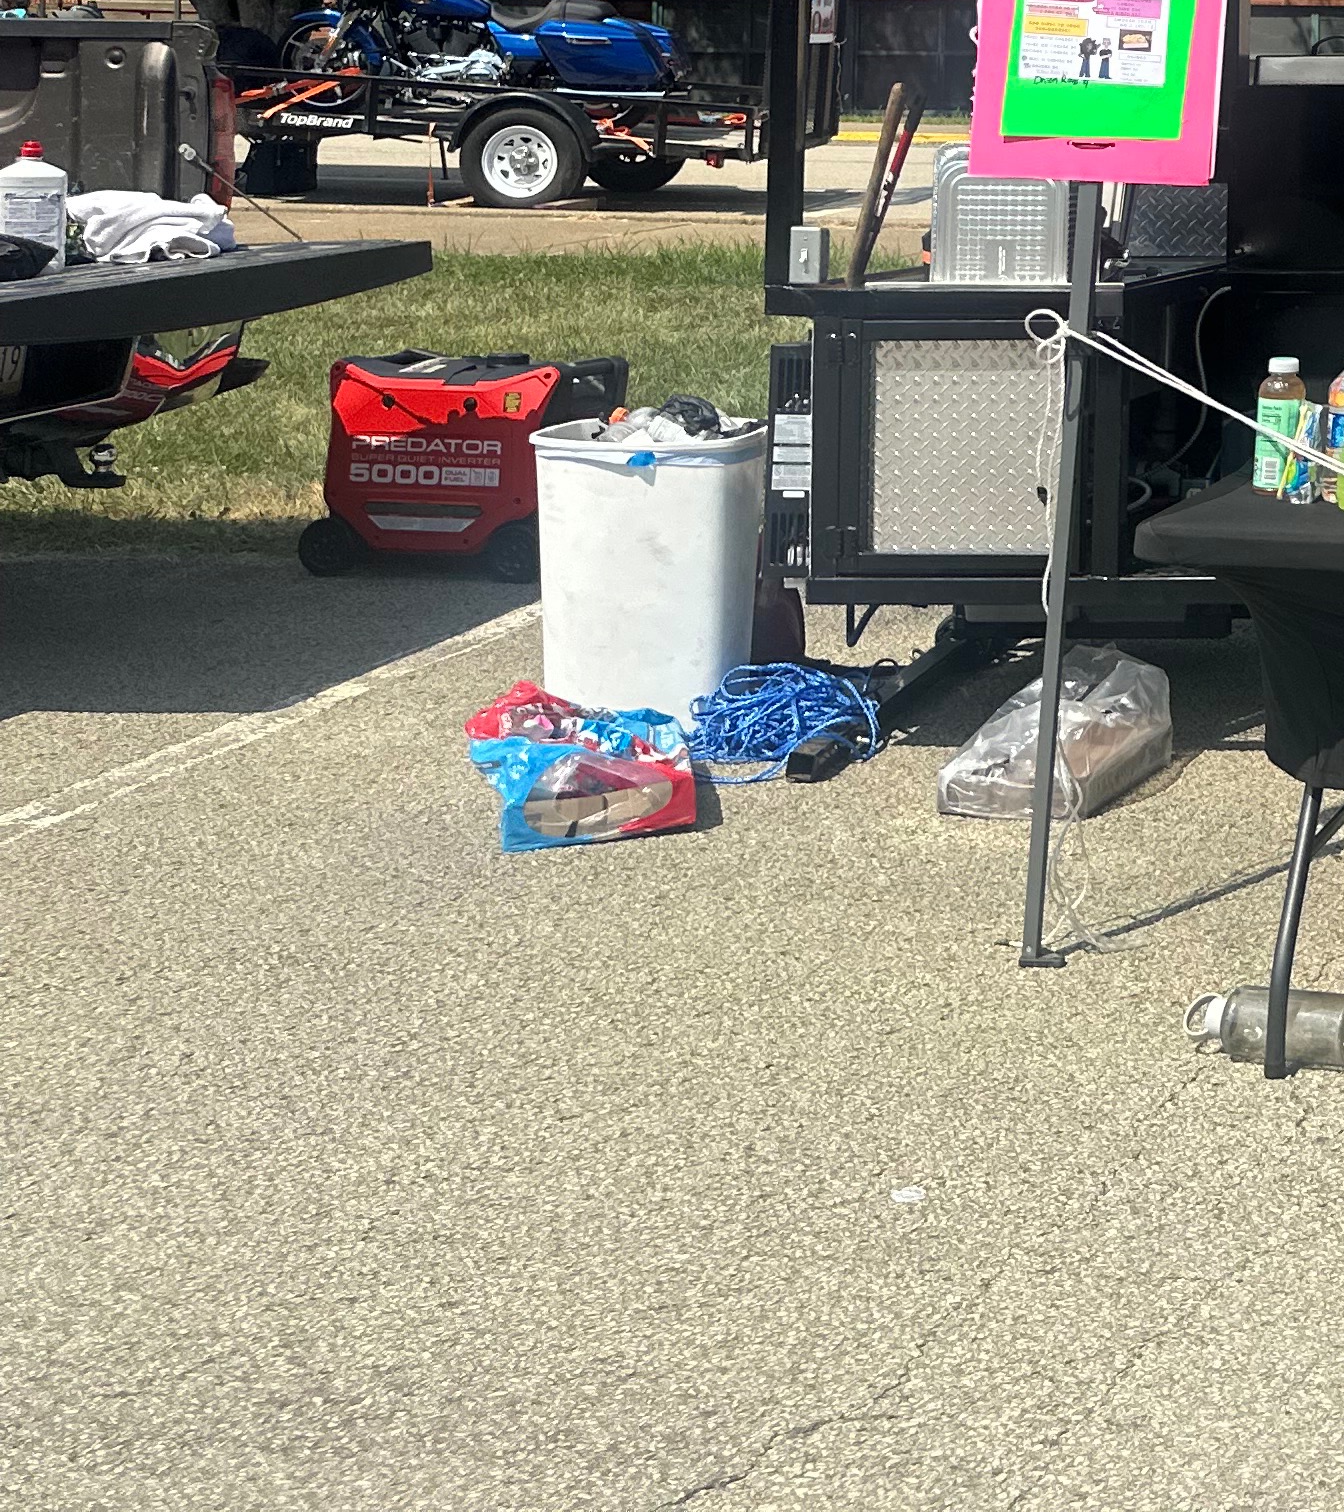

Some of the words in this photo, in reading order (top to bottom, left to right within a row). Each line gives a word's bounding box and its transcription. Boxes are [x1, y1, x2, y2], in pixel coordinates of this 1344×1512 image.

[281, 112, 354, 128] TopBrand
[351, 435, 502, 455] PREDATOR
[351, 453, 395, 462] SUPER
[397, 454, 435, 464] QUIET
[438, 456, 501, 466] INVERTER
[350, 463, 440, 485] 5000
